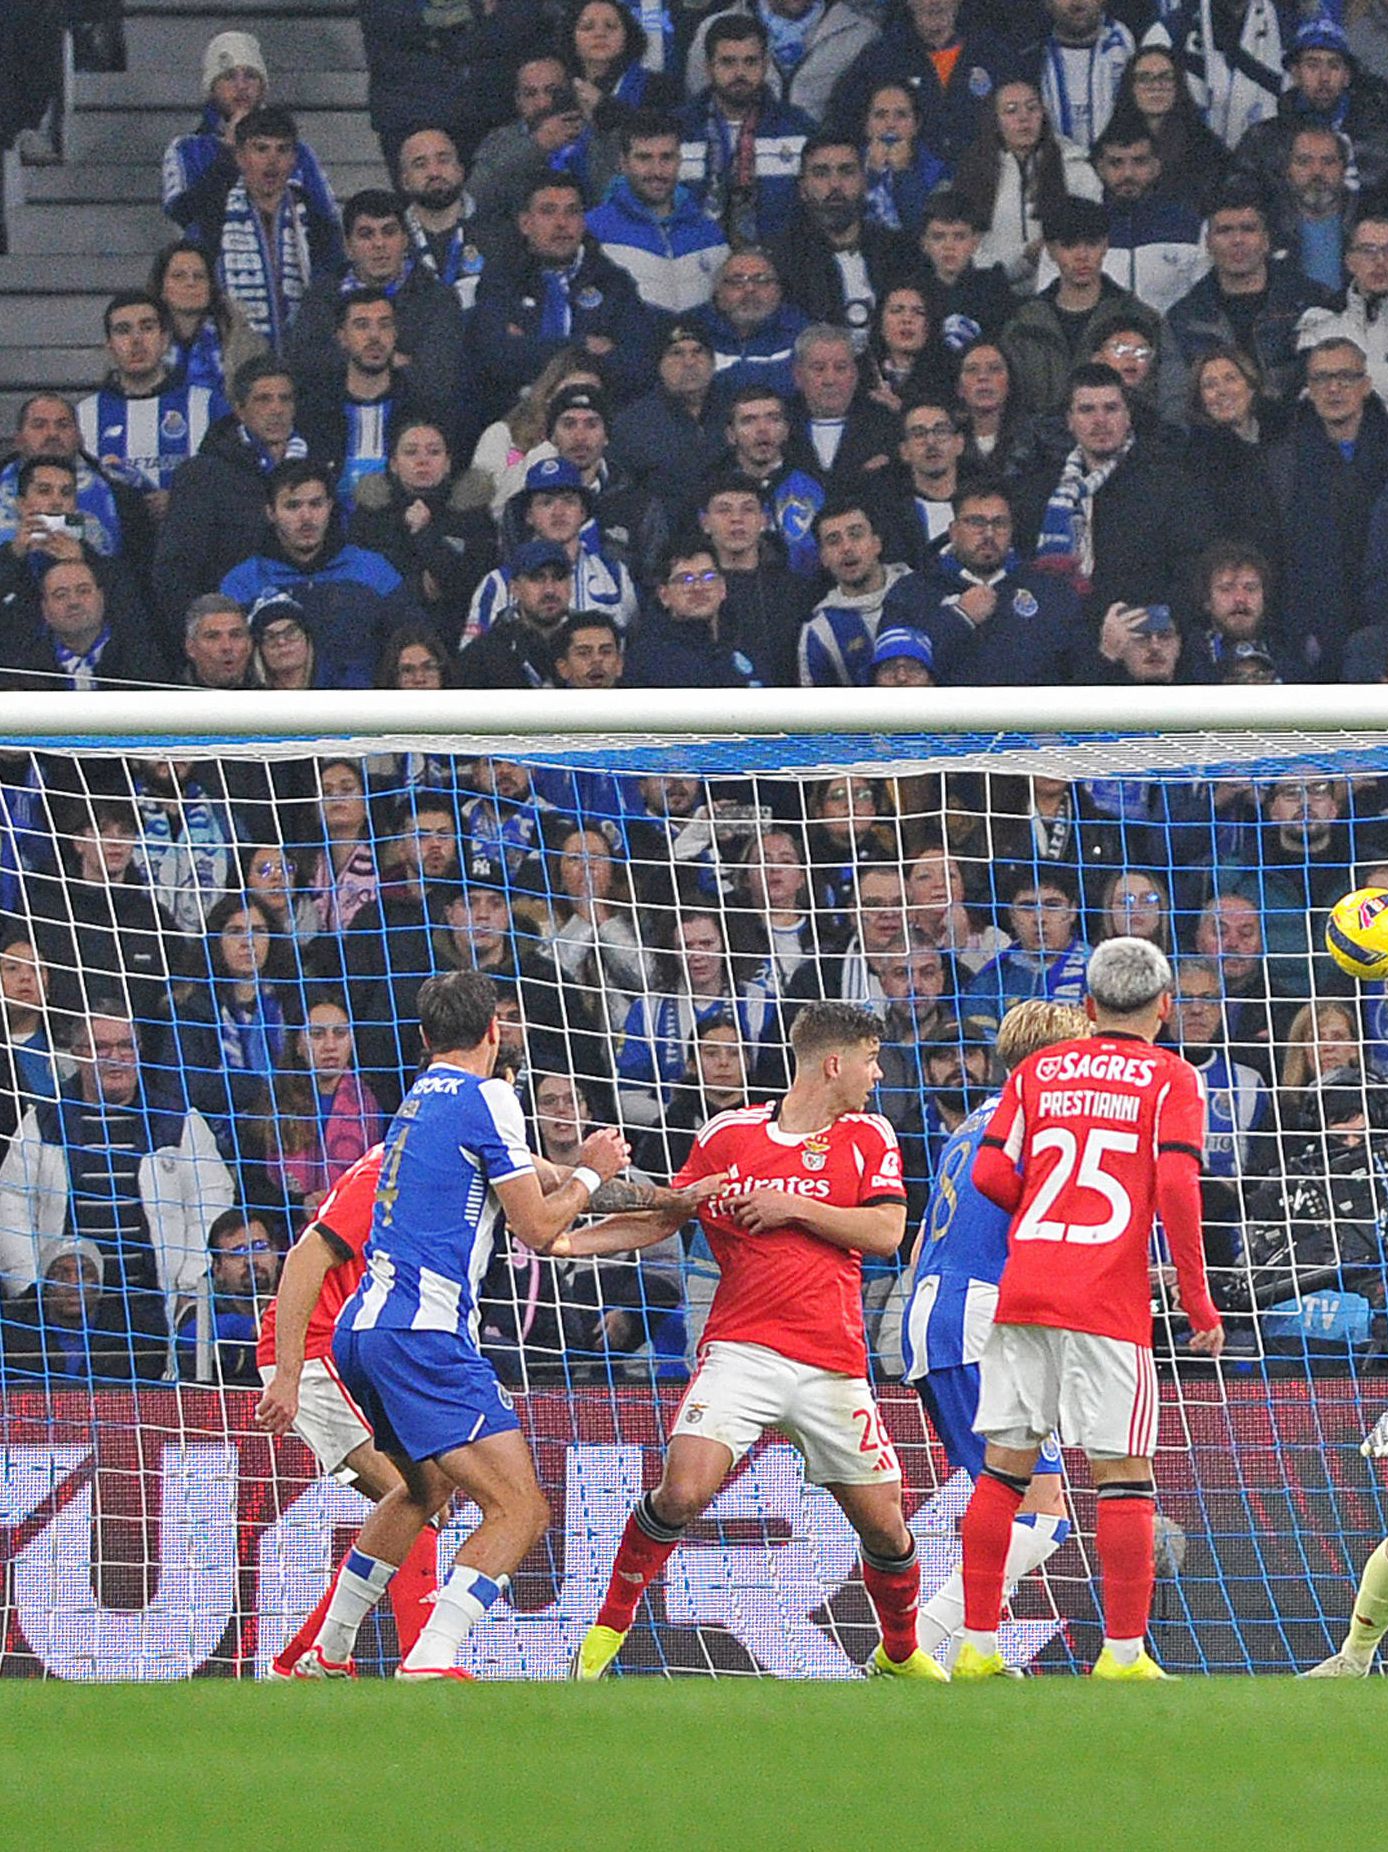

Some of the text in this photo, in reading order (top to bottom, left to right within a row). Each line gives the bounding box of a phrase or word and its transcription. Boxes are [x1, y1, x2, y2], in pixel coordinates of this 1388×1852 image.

[1057, 1051, 1157, 1087] SAGRES
[1038, 1090, 1141, 1122] PRESTIANNI
[931, 1140, 972, 1243] 8
[1014, 1127, 1132, 1245] 25
[1302, 1296, 1340, 1330] TV
